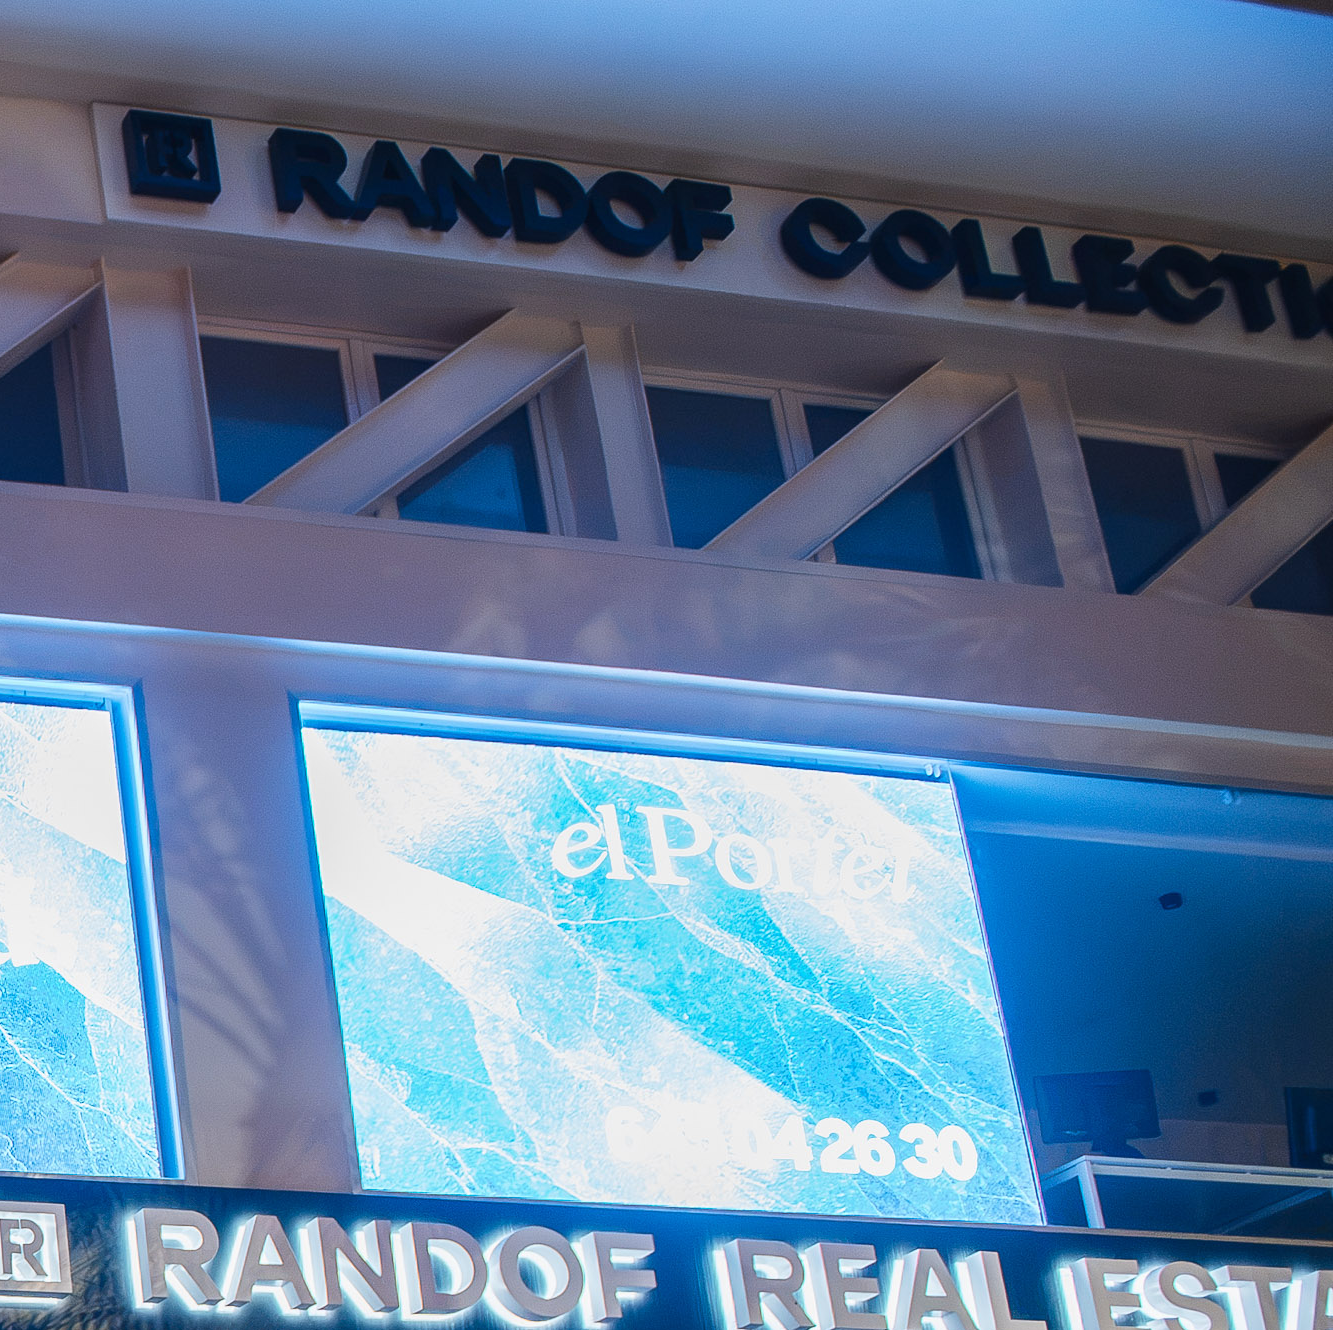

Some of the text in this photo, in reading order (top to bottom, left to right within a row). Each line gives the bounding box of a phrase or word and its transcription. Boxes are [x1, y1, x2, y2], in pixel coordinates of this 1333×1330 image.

[268, 127, 1333, 341] RANDOF COLLECTI
[814, 1117, 896, 1177] 26
[899, 1122, 979, 1182] 30
[128, 1208, 657, 1323] RANDOF
